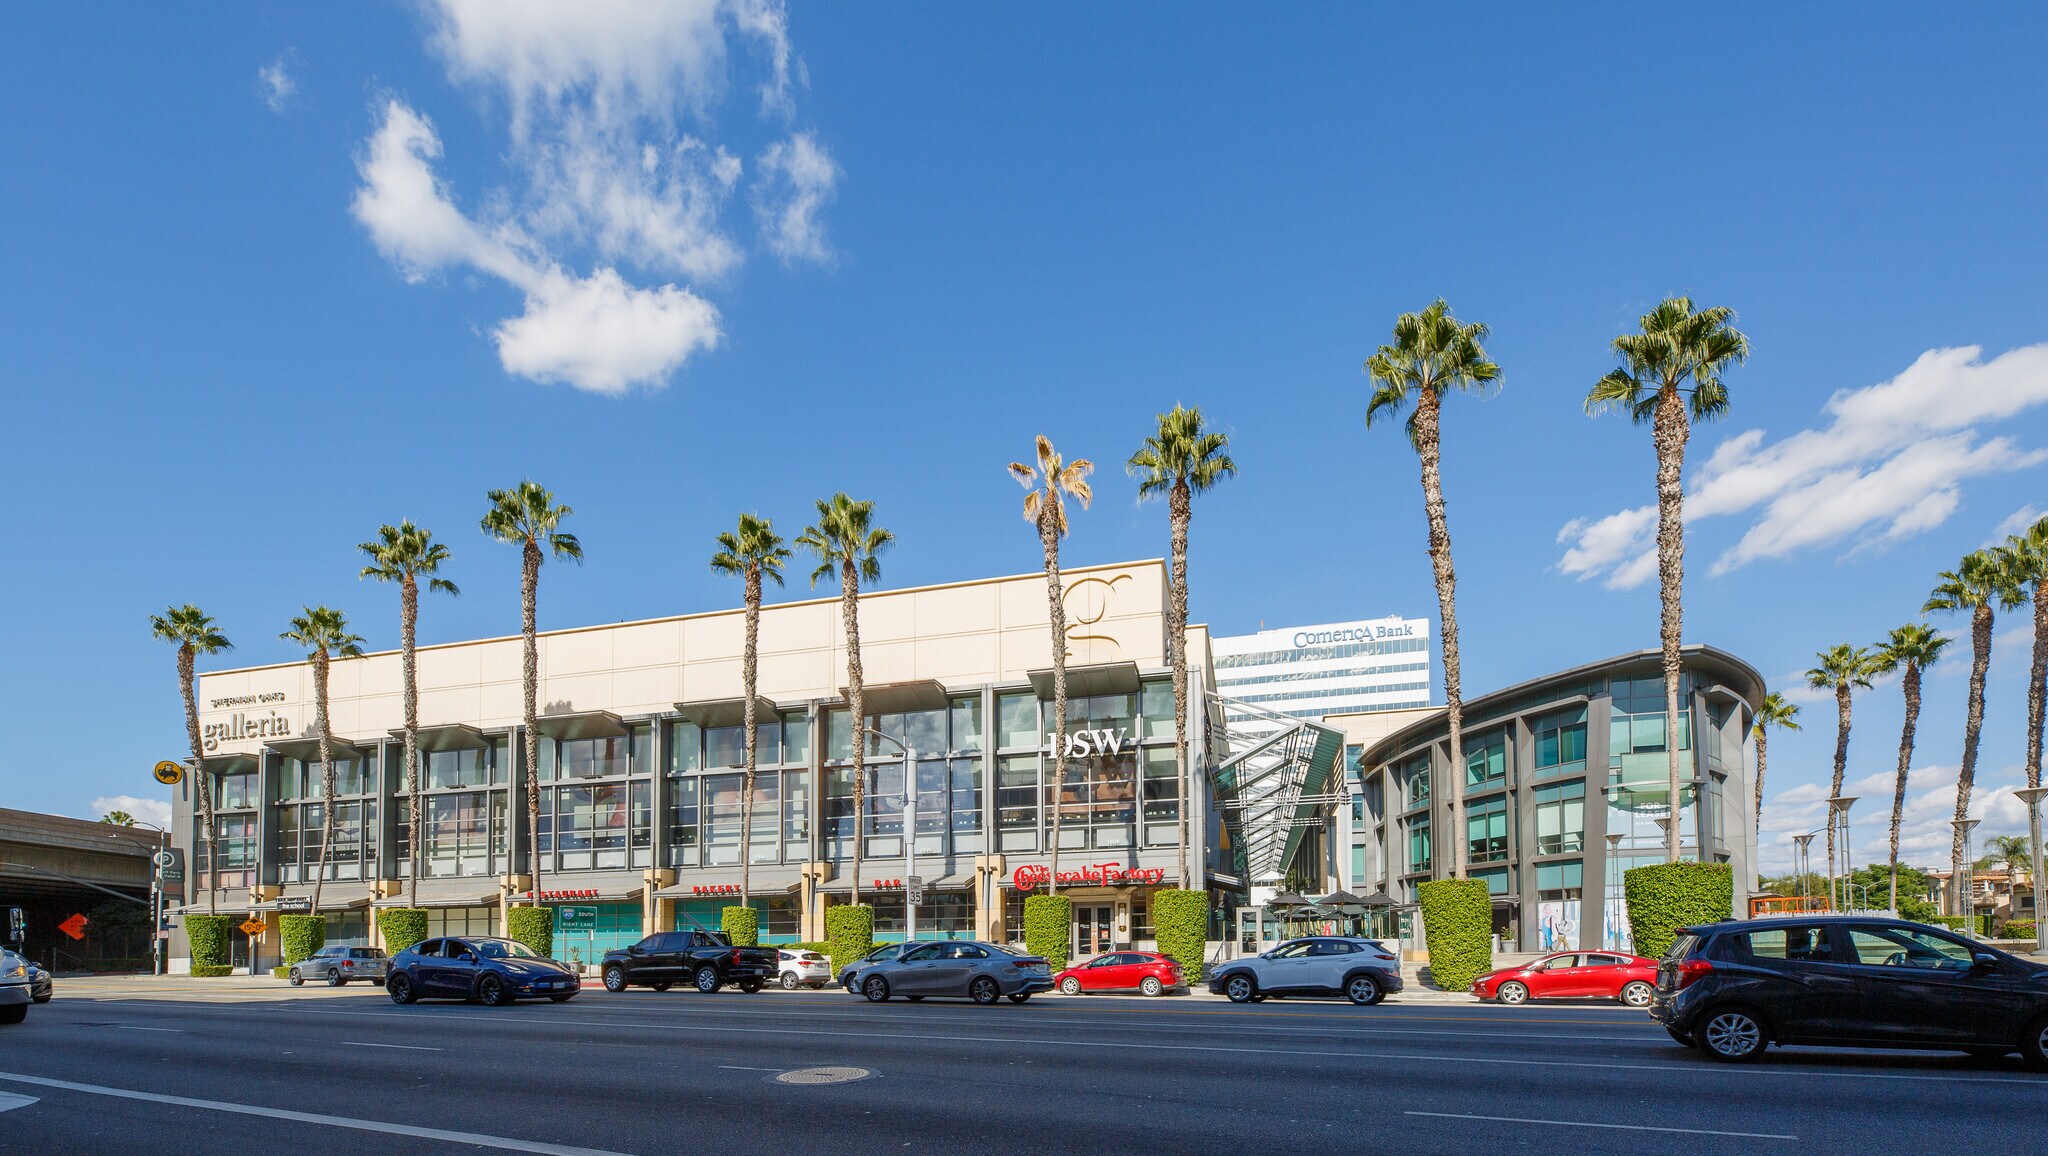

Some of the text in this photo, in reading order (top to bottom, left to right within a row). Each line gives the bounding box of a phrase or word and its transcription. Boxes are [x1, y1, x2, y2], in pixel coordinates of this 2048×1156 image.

[1376, 623, 1413, 639] Bank
[211, 692, 286, 708] SHERMAN OAKS
[204, 710, 291, 752] galleria
[1047, 727, 1128, 759] DSW
[1635, 810, 1666, 818] LEASE
[1033, 864, 1049, 873] The
[1093, 862, 1165, 888] Factory
[692, 884, 740, 894] BAKERY
[874, 879, 901, 888] BAR
[526, 887, 599, 898] RSTAURANT
[910, 891, 920, 902] 35
